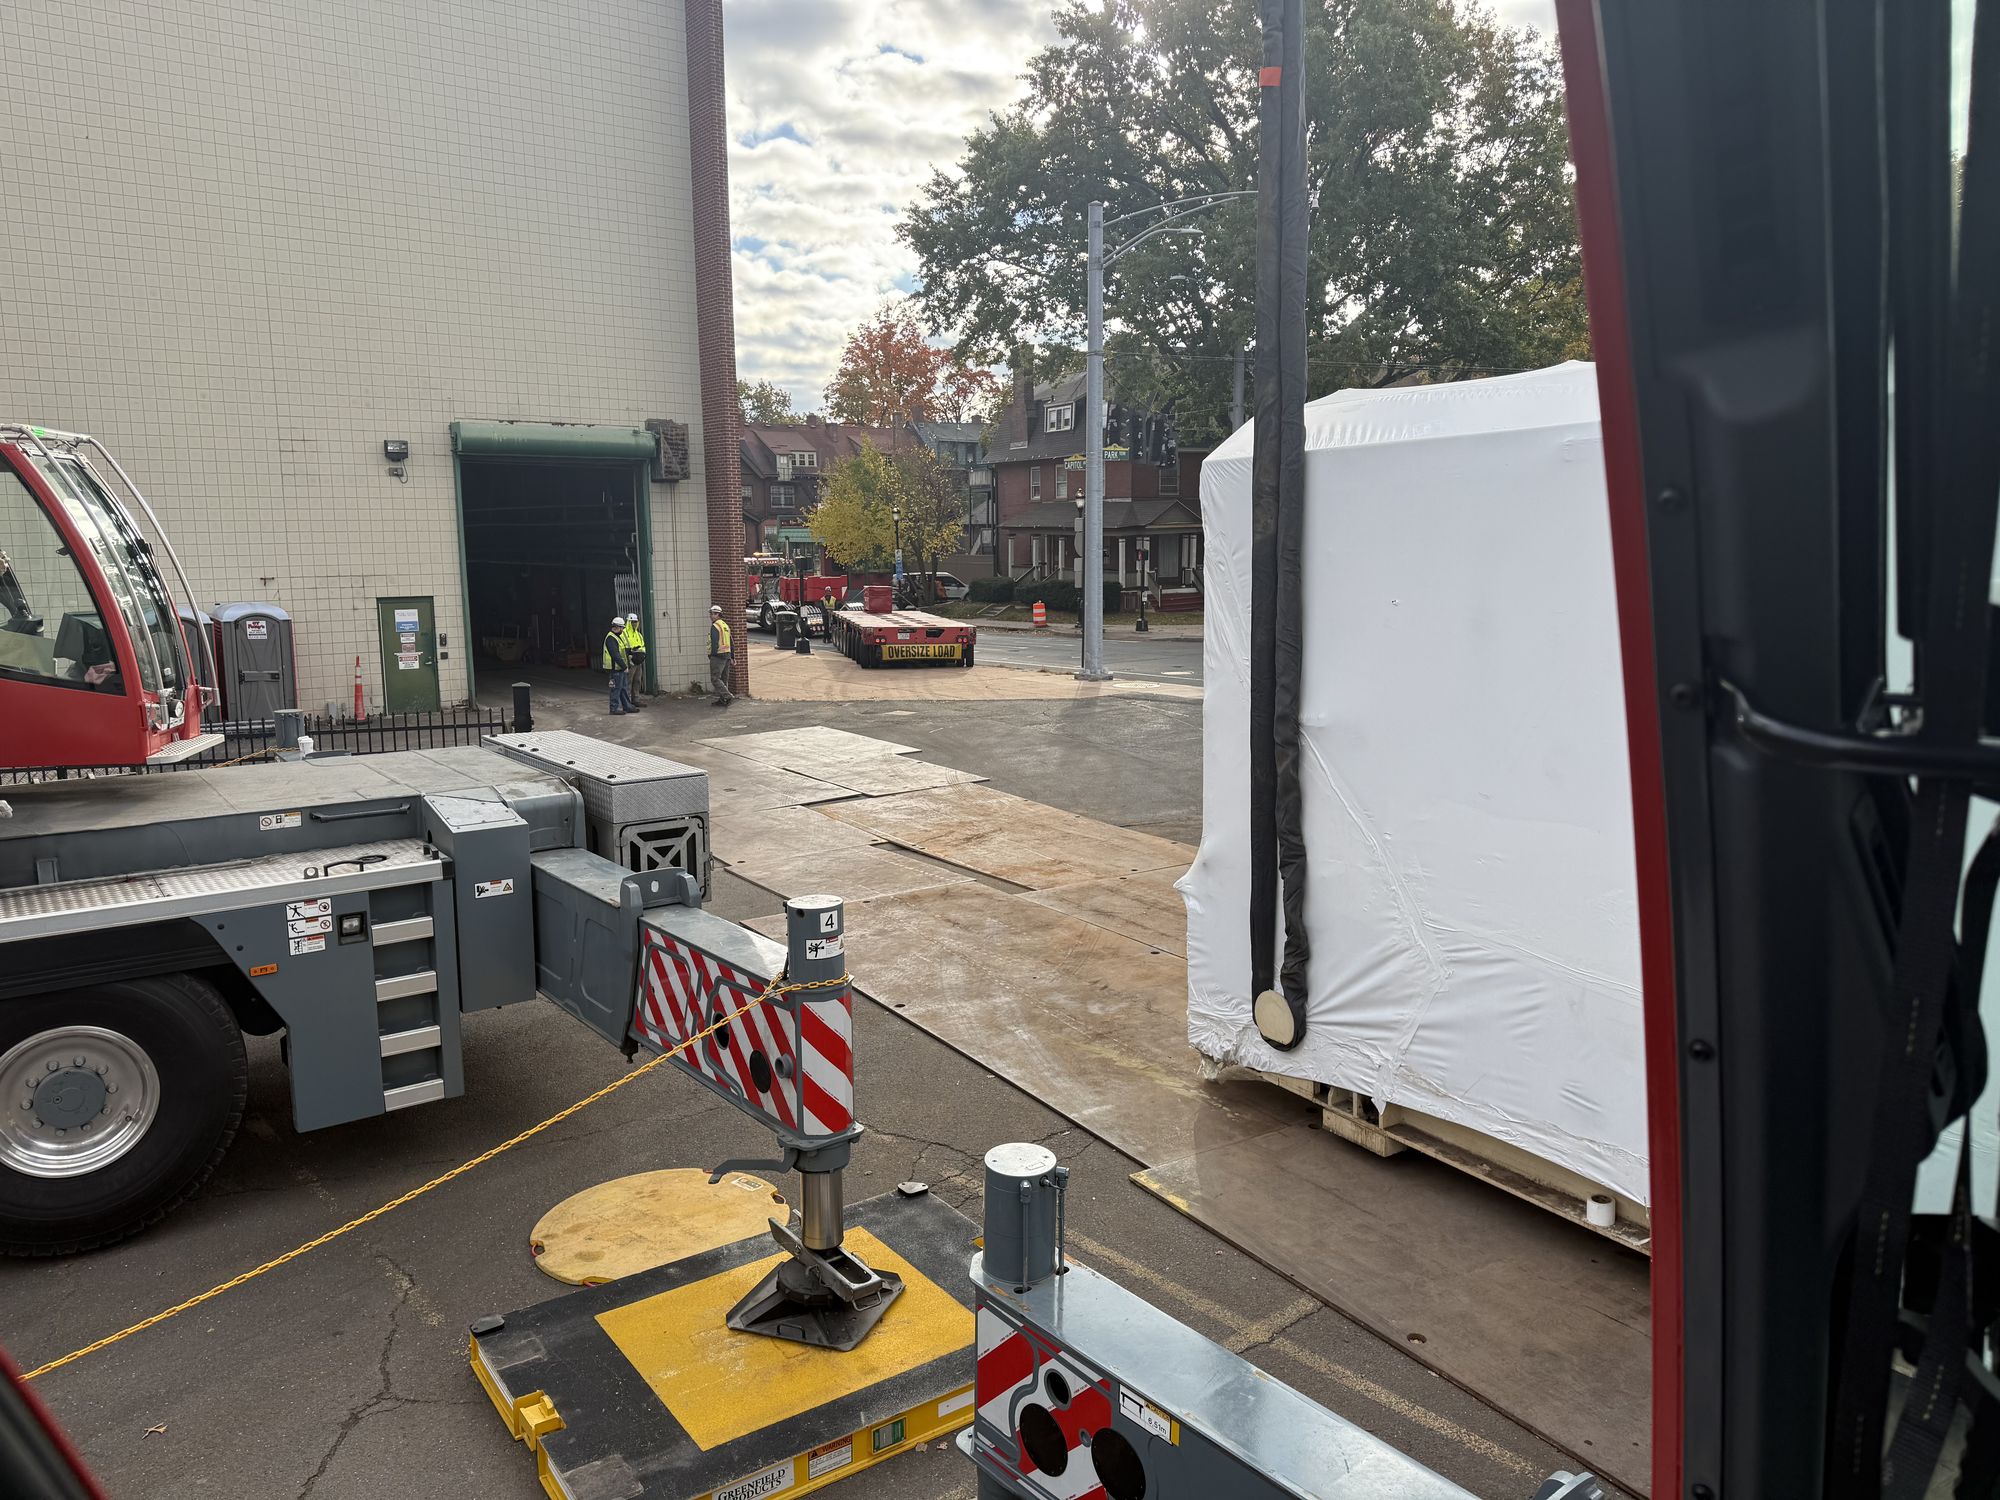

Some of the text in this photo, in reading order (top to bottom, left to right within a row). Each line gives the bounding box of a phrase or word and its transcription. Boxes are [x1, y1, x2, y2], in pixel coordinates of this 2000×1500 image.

[1104, 451, 1119, 459] PARK
[1064, 461, 1083, 470] CAPITOL
[888, 645, 955, 659] OVERSIZE LOAD
[825, 913, 834, 929] 4
[821, 1436, 851, 1452] WARNING
[718, 1468, 786, 1500] GREENFIELD
